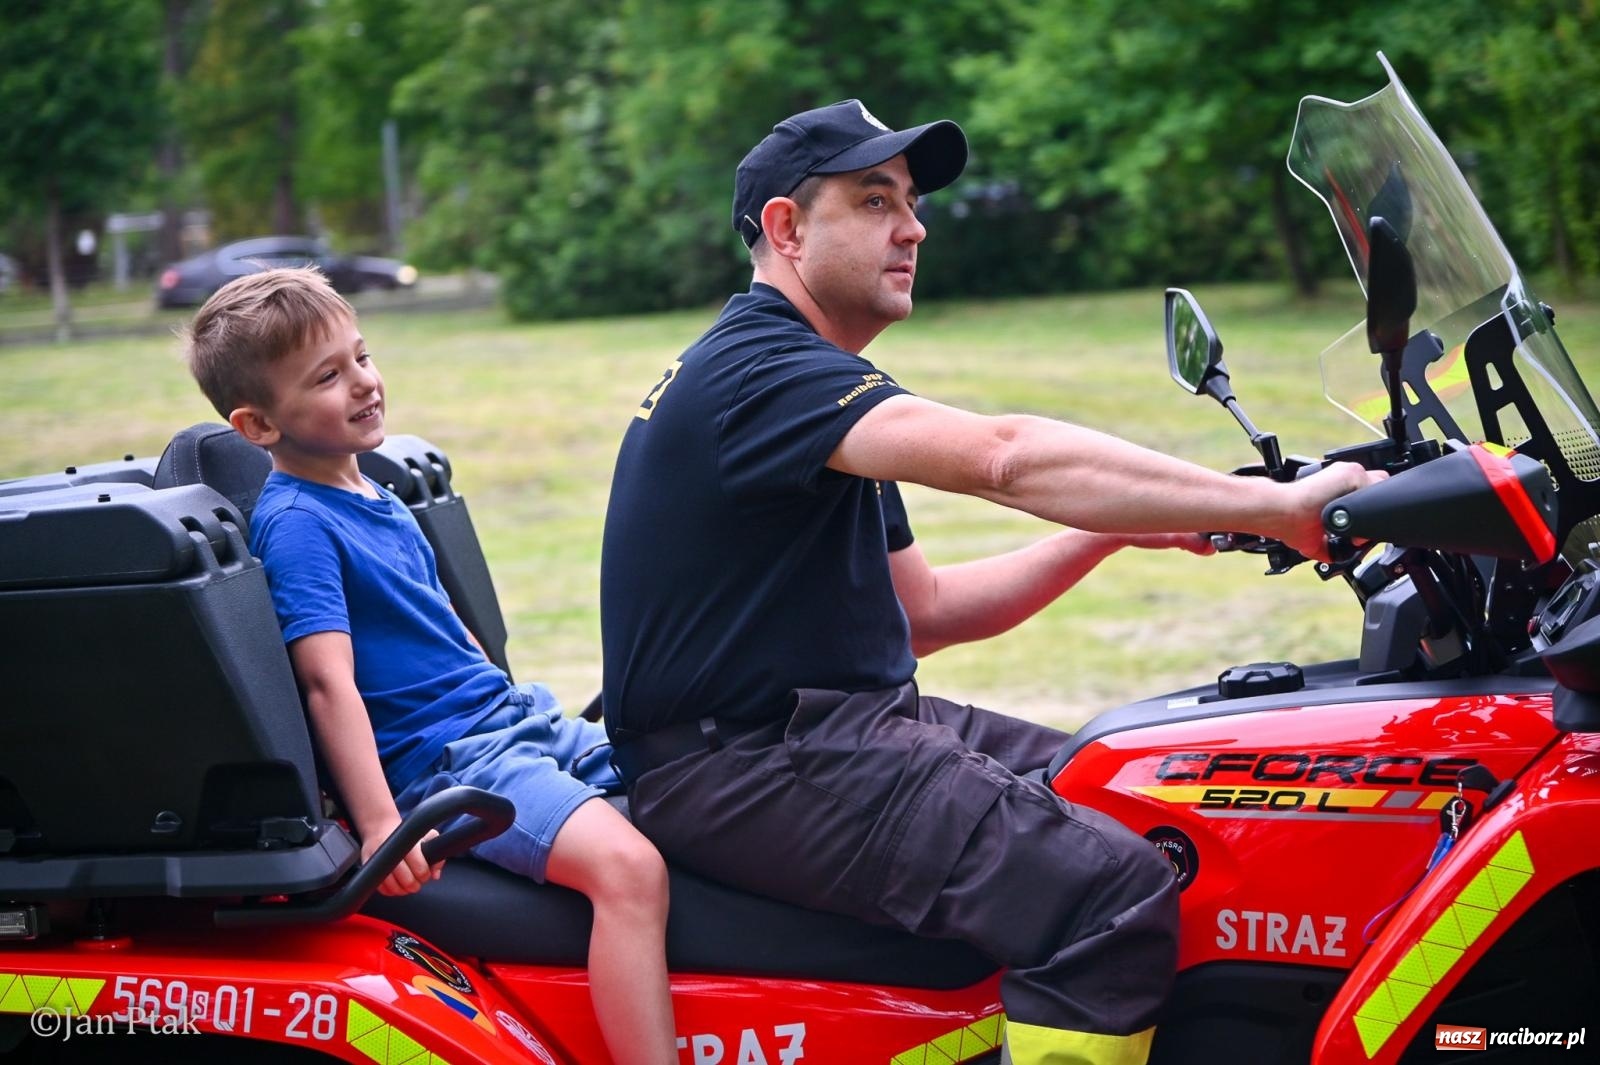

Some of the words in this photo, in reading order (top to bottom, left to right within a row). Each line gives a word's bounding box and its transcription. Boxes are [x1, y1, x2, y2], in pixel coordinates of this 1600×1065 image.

[1155, 753, 1478, 786] CFORCE
[1201, 789, 1307, 810] 520
[1316, 792, 1349, 813] L
